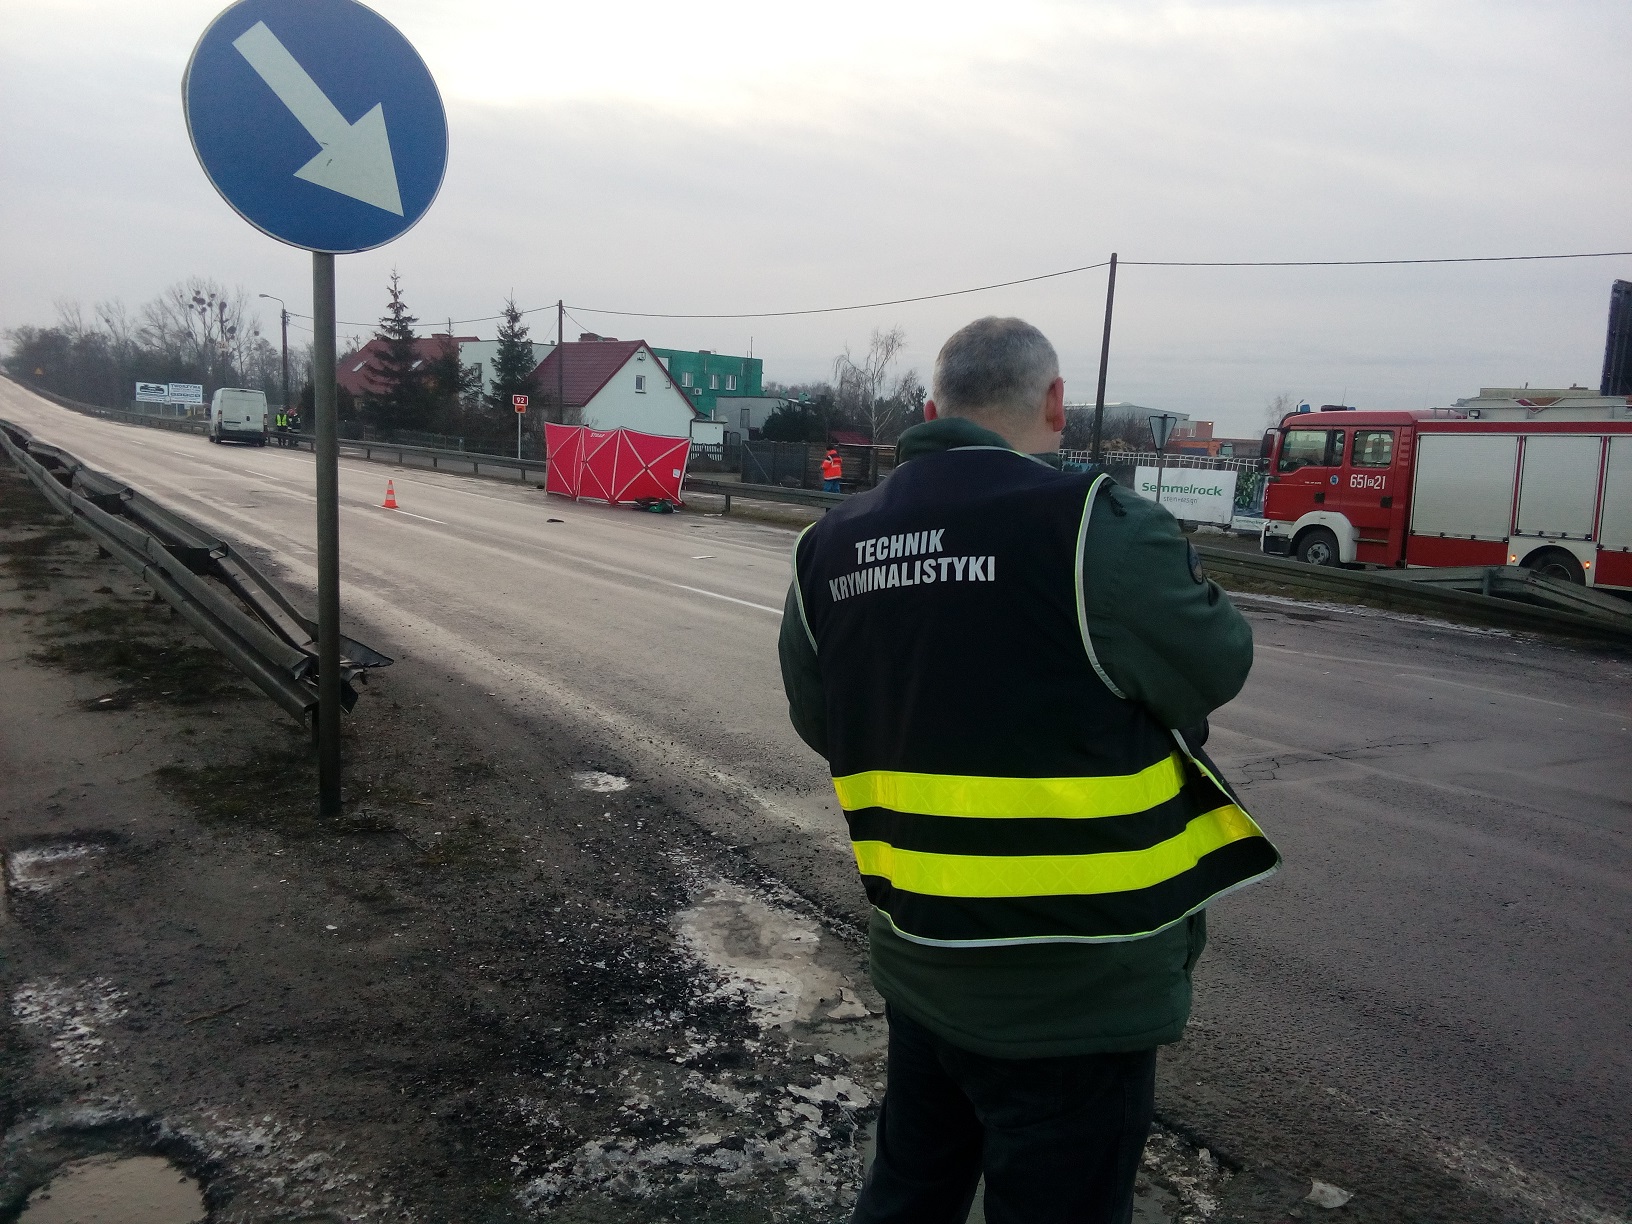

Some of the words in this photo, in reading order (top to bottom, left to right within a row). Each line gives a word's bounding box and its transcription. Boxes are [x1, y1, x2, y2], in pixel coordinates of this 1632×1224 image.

[1141, 482, 1223, 497] Semmelrock
[855, 528, 946, 565] TECHNIK
[828, 555, 996, 602] KRYMINALISTYKI
